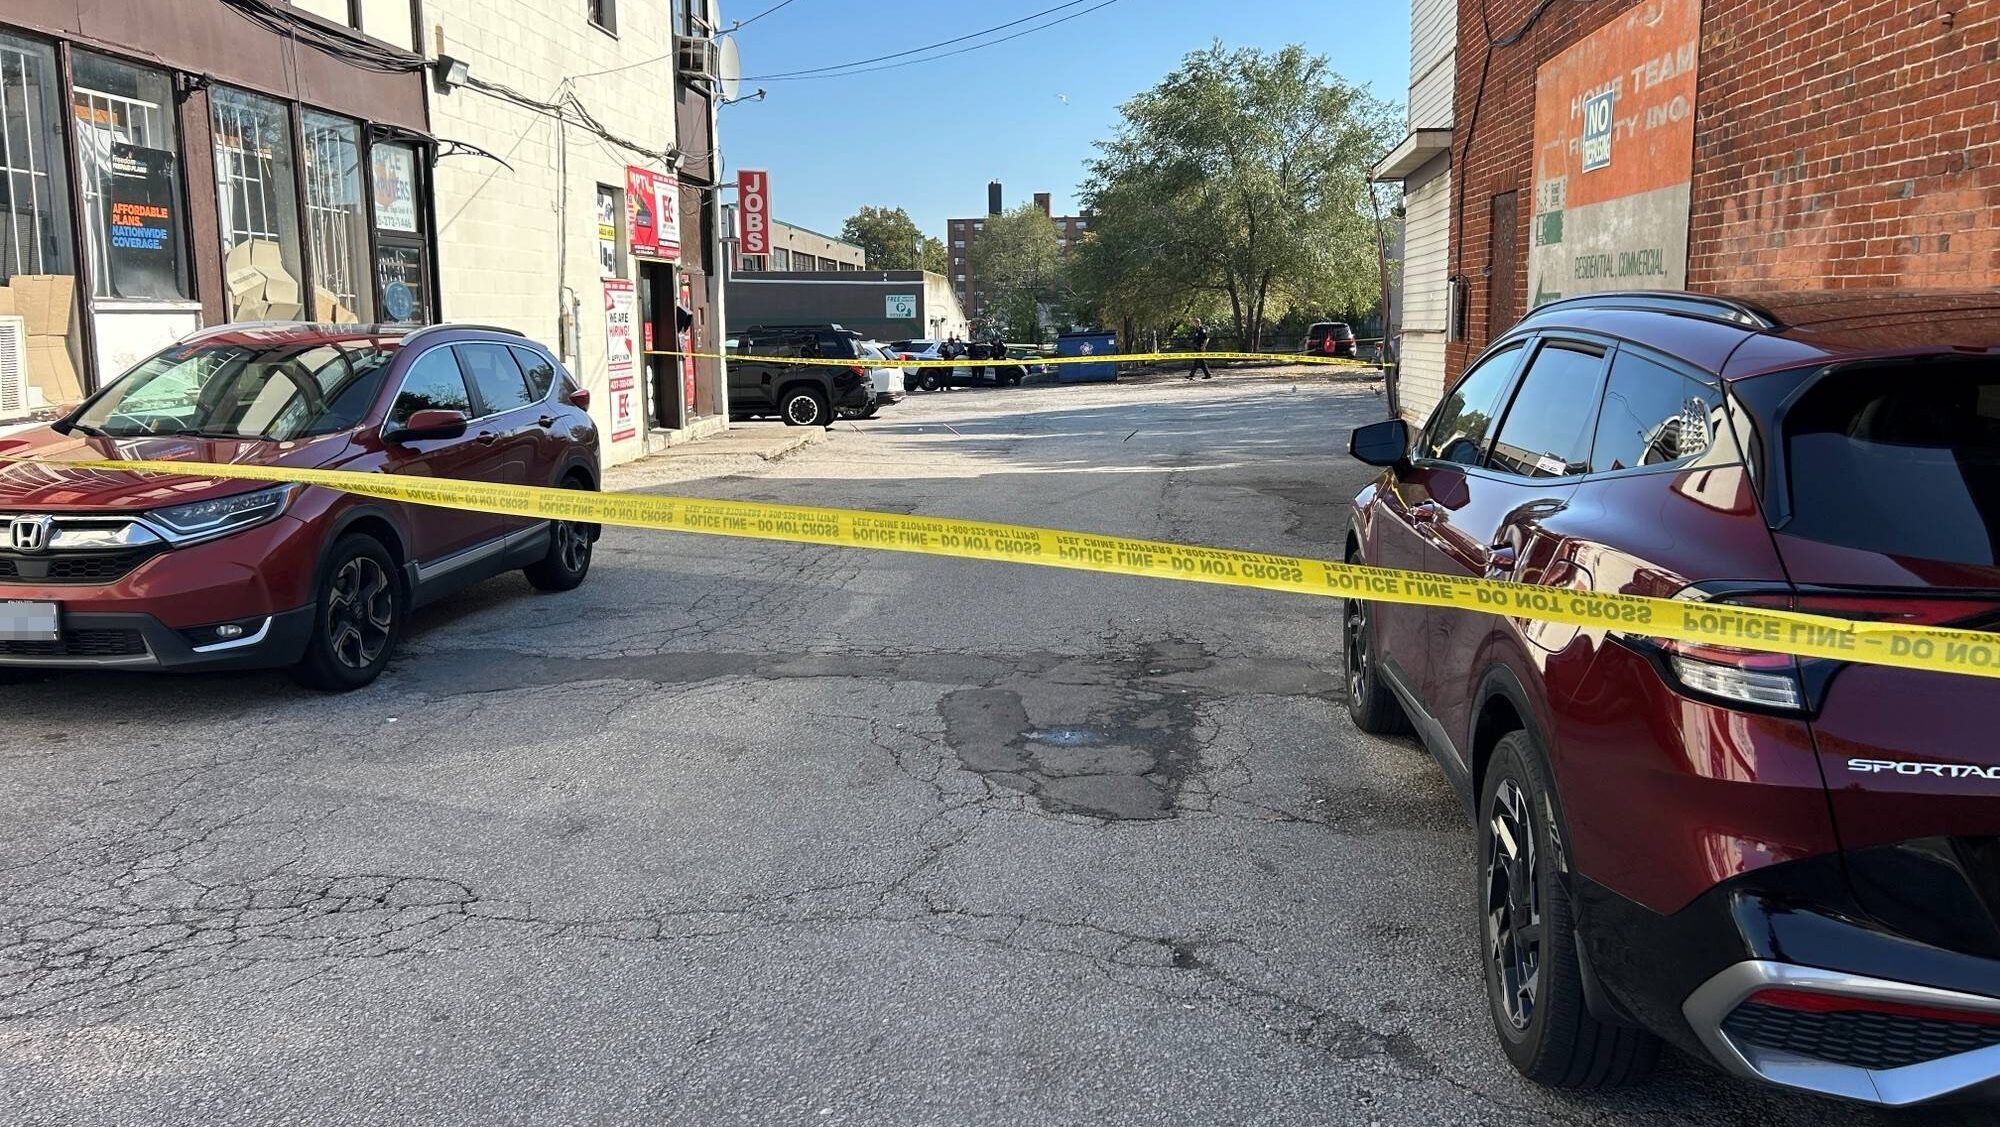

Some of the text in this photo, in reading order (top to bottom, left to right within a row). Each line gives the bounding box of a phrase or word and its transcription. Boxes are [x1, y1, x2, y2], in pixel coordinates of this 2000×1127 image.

[1631, 40, 1695, 94] TEAM
[1588, 98, 1609, 137] NO
[112, 202, 168, 218] AFFORDABLE
[744, 174, 763, 252] JOBS
[112, 214, 143, 227] PLANS.
[112, 225, 168, 240] NATIONWIDE
[112, 237, 163, 250] COVERAGE.
[1618, 248, 1668, 278] COMMERCIAL,
[618, 312, 629, 323] ARE
